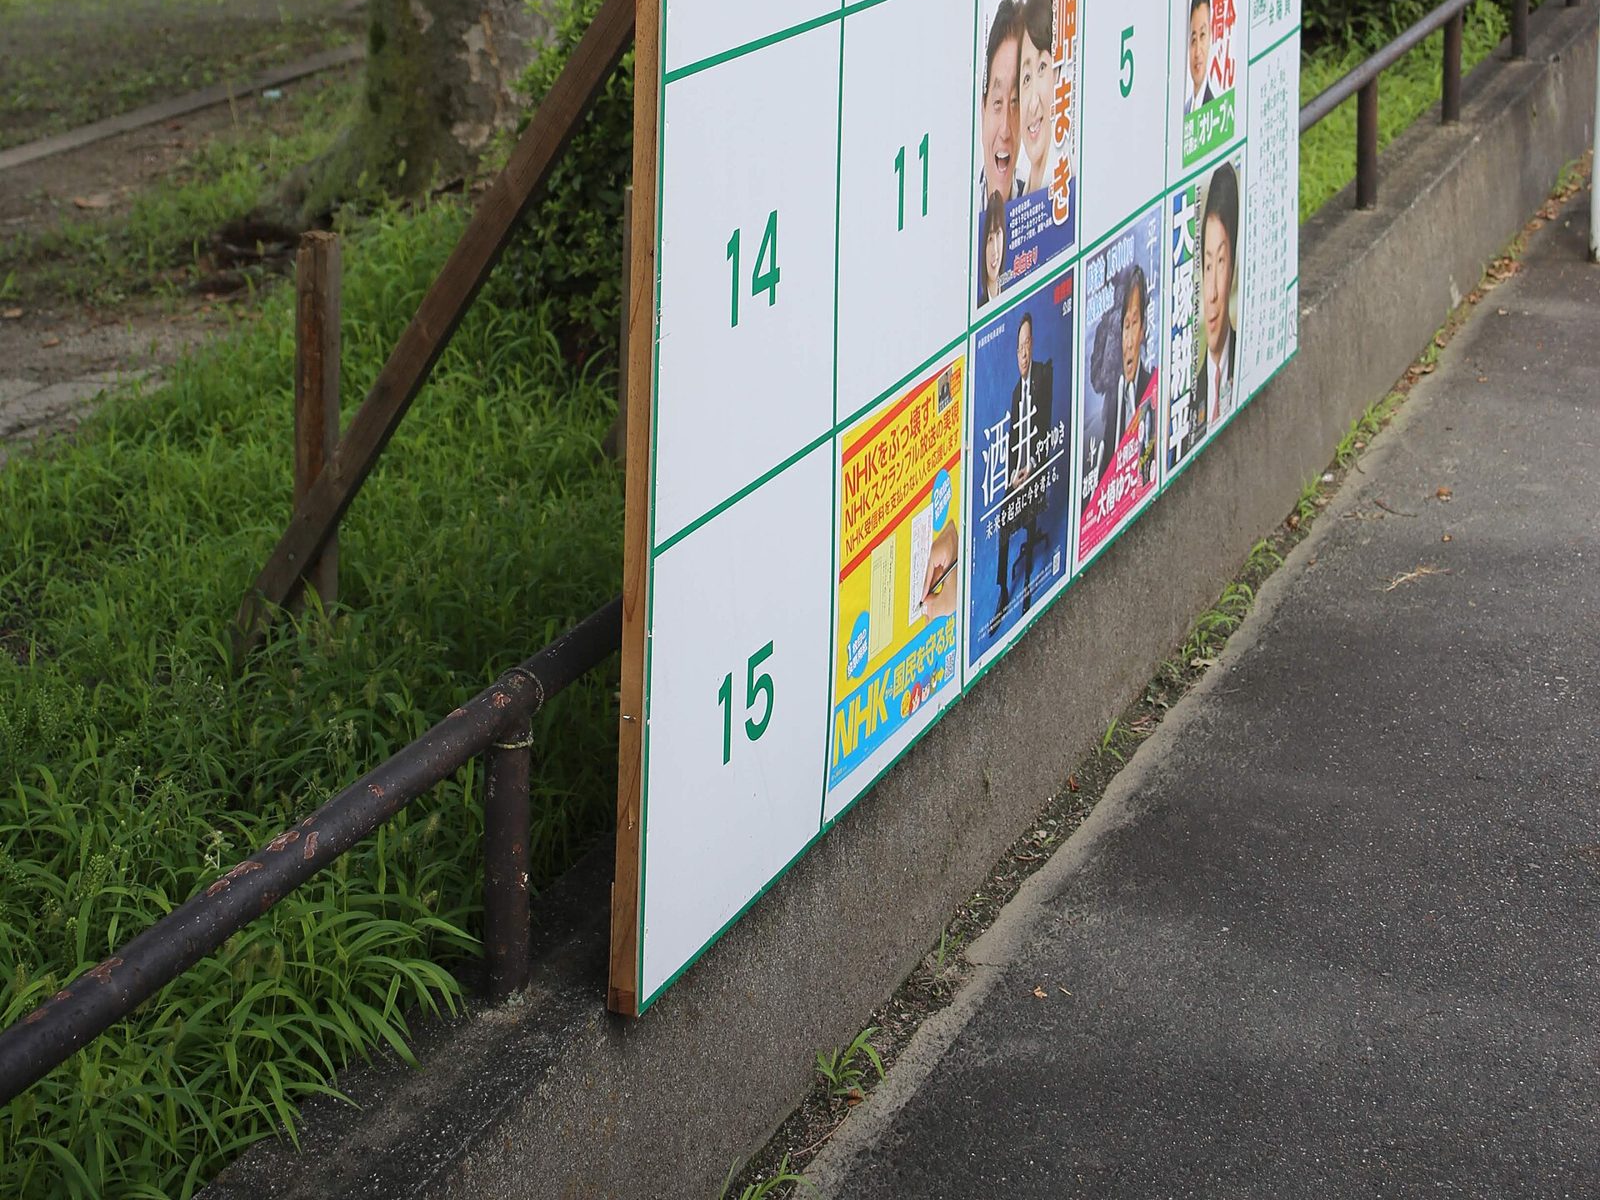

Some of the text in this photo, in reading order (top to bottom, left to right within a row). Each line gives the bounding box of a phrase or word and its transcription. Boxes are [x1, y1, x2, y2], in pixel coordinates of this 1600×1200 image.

[1119, 25, 1135, 98] 5
[1210, 44, 1234, 88] べん
[895, 133, 930, 232] 11
[727, 211, 781, 328] 14
[1145, 217, 1157, 371] 平山良平
[1169, 191, 1194, 463] 大塚耕平
[844, 400, 960, 533] NHKスクランブル放送の実現
[845, 429, 960, 554] NHK受信料を支払わない人を応援します
[981, 394, 1065, 507] 酒井 やすゆき
[985, 466, 1059, 540] 未来を起点に今を考える。
[1096, 460, 1139, 523] 大椿ゆうこ
[718, 642, 775, 766] 15
